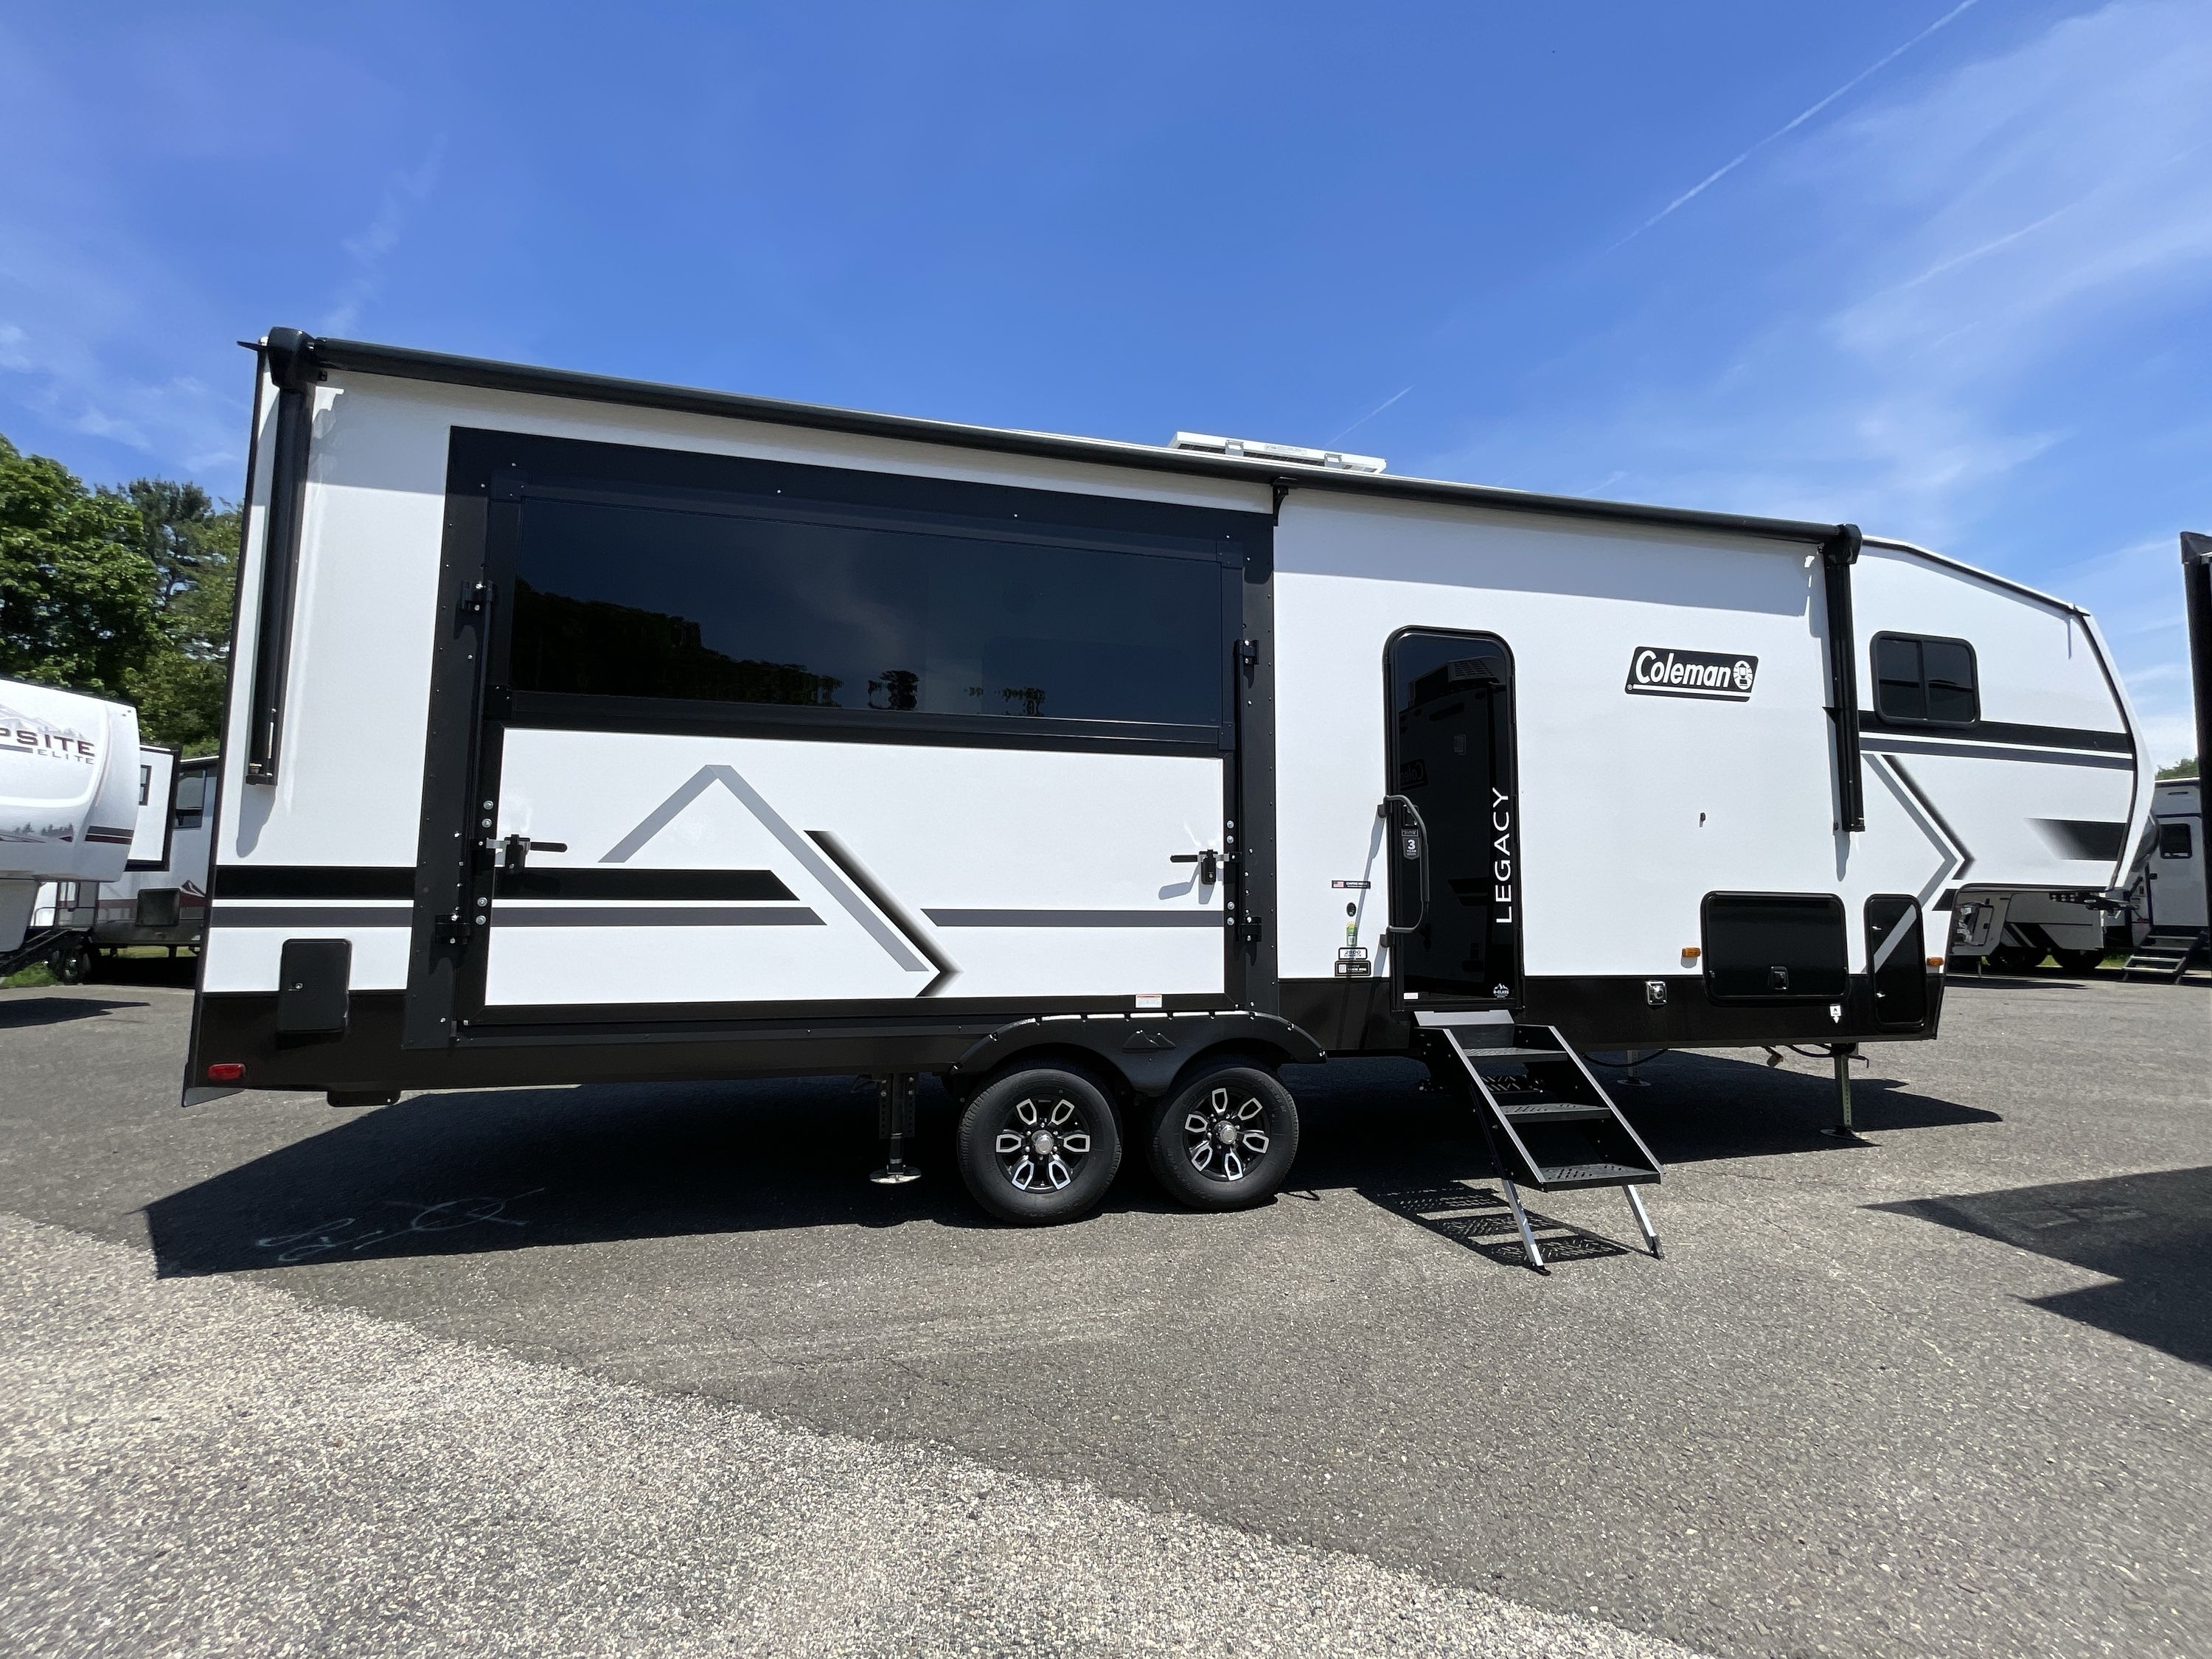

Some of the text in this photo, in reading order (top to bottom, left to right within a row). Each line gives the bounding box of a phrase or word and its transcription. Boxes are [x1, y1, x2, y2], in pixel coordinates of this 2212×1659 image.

[1635, 650, 1731, 688] Coleman
[38, 748, 94, 765] ELITE
[1408, 839, 1416, 850] 3
[1492, 787, 1512, 923] LEGACY
